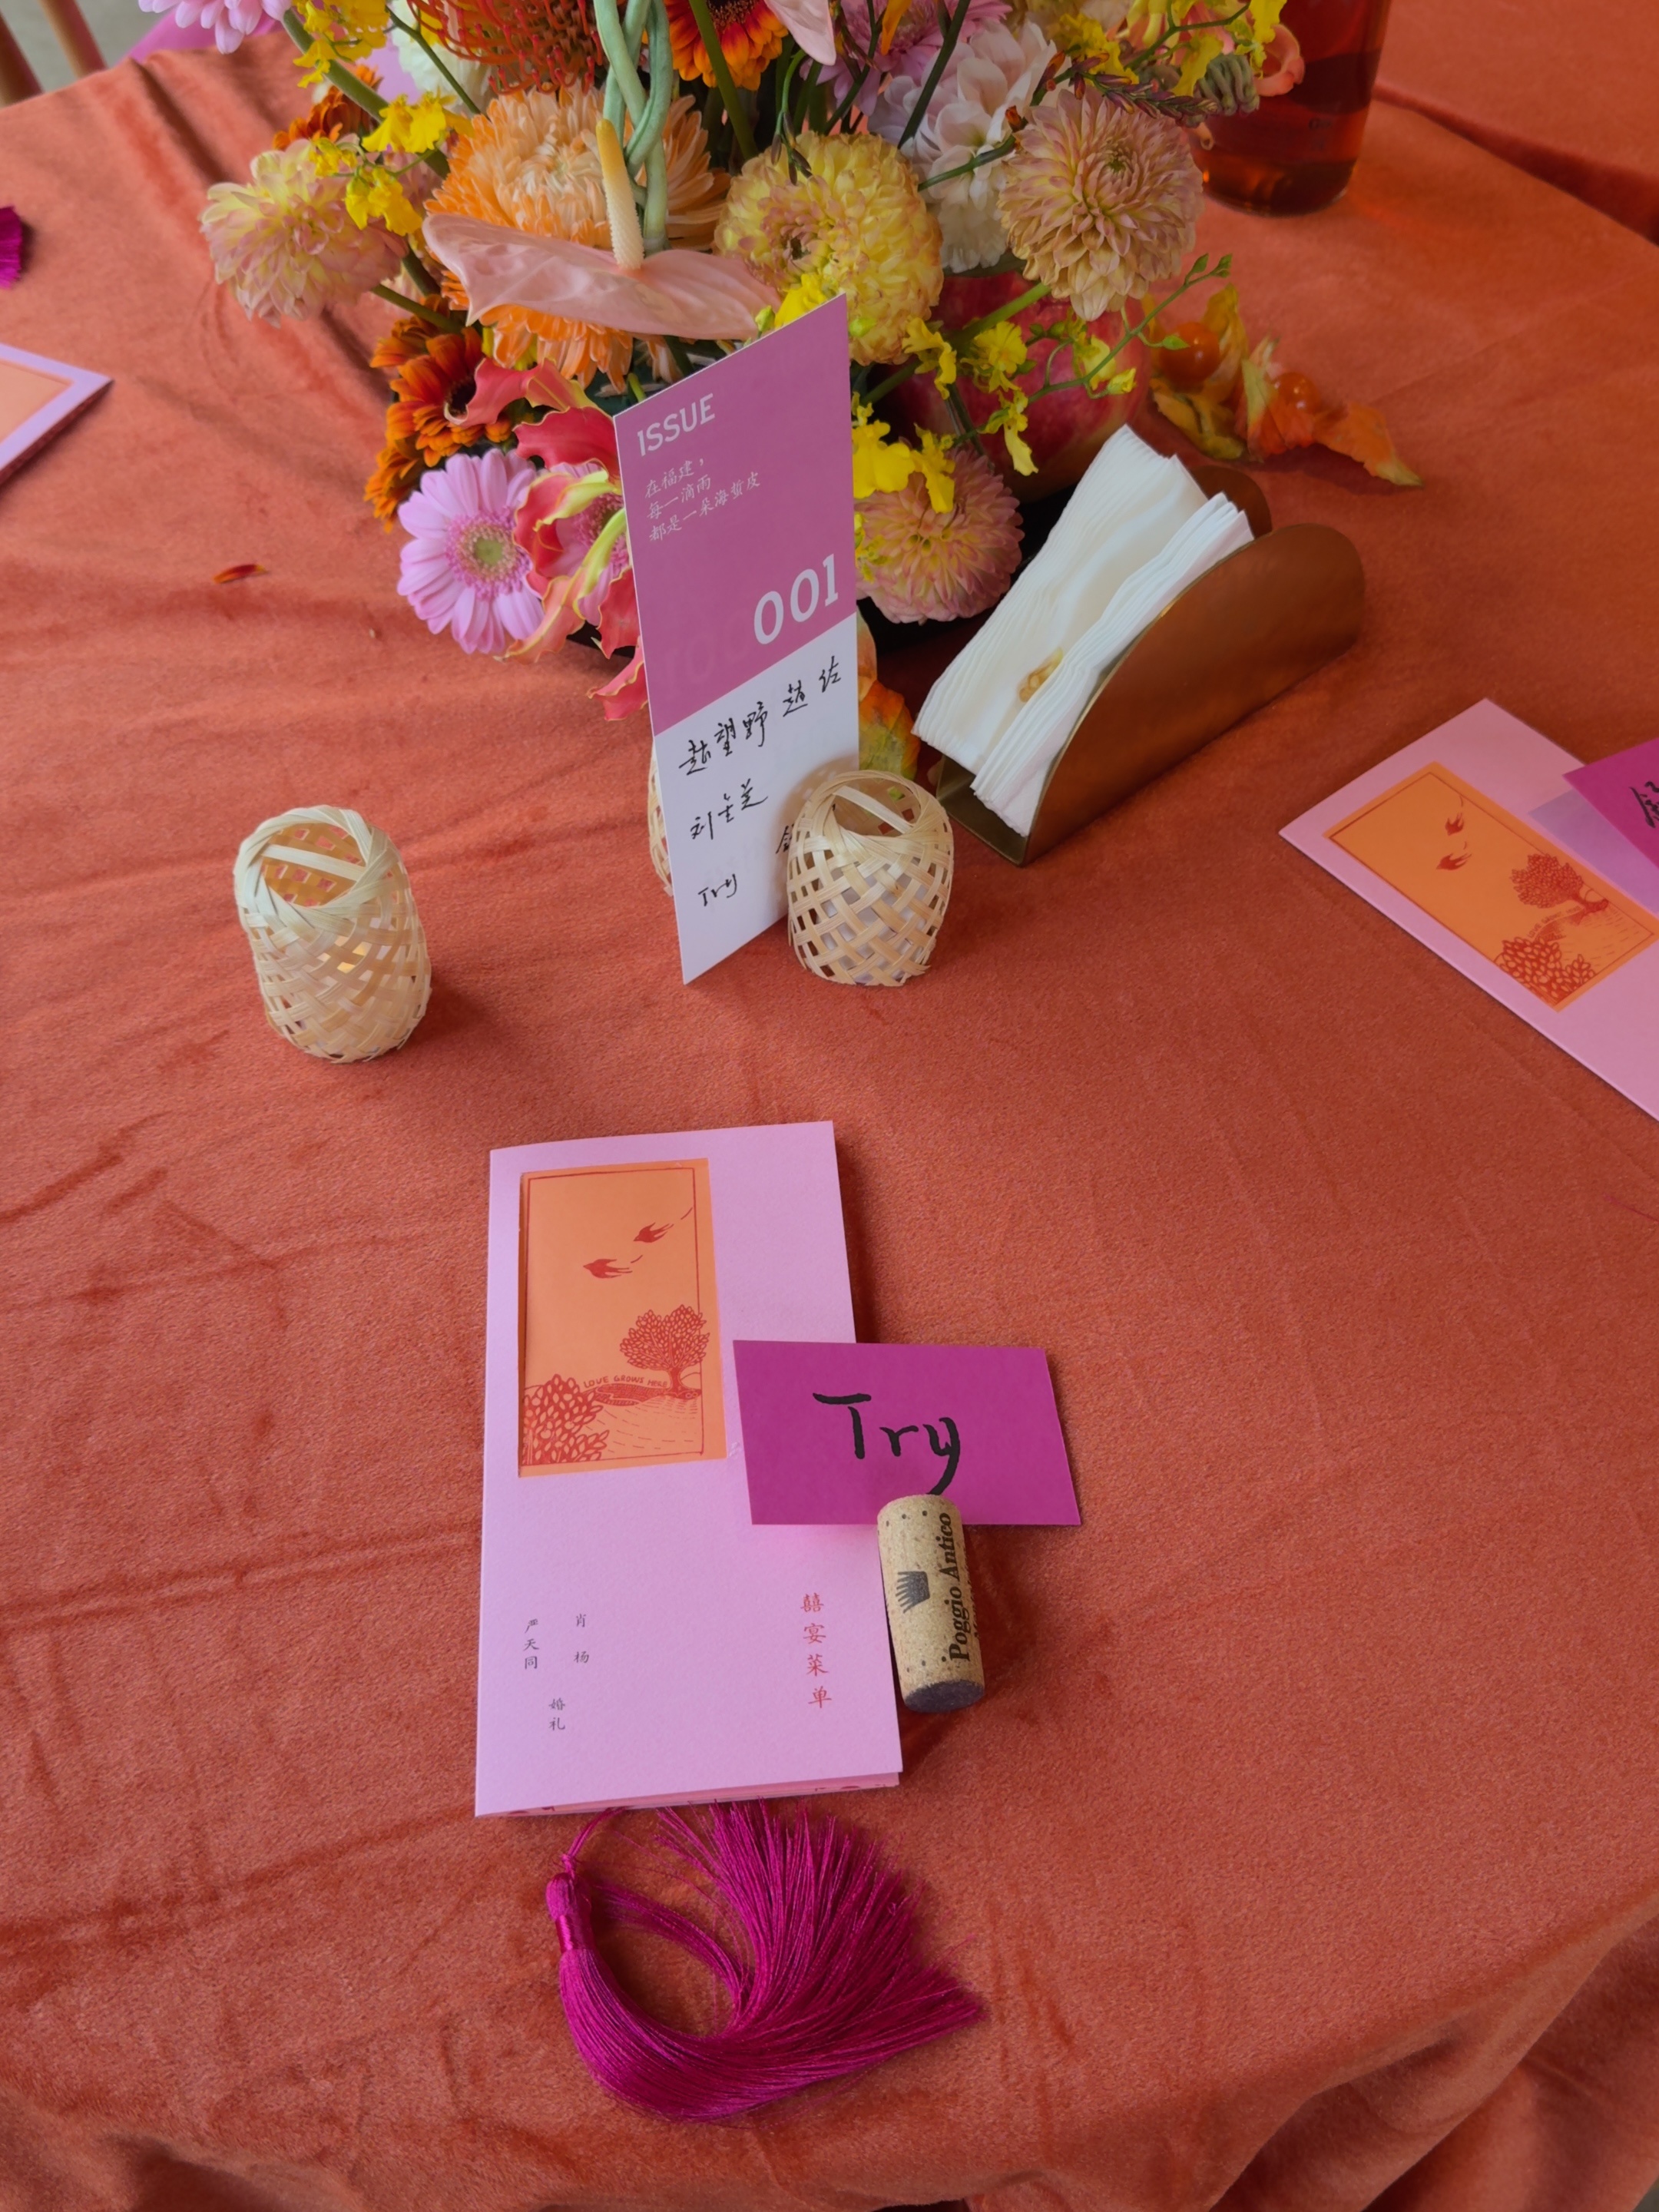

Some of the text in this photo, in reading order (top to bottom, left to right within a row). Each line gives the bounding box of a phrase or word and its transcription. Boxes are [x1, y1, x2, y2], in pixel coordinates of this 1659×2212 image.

[637, 393, 716, 456] ISSUE
[647, 474, 711, 519] 每一滴雨
[649, 472, 760, 541] 都是一朵海蜇皮
[754, 553, 839, 644] 001
[698, 873, 737, 906] Try
[584, 1375, 667, 1389] LOVE GROWS HERE
[812, 1392, 961, 1495] Try
[935, 1512, 971, 1661] Poggio Antico
[523, 1618, 539, 1670] 严天同
[548, 1697, 566, 1730] 婚礼
